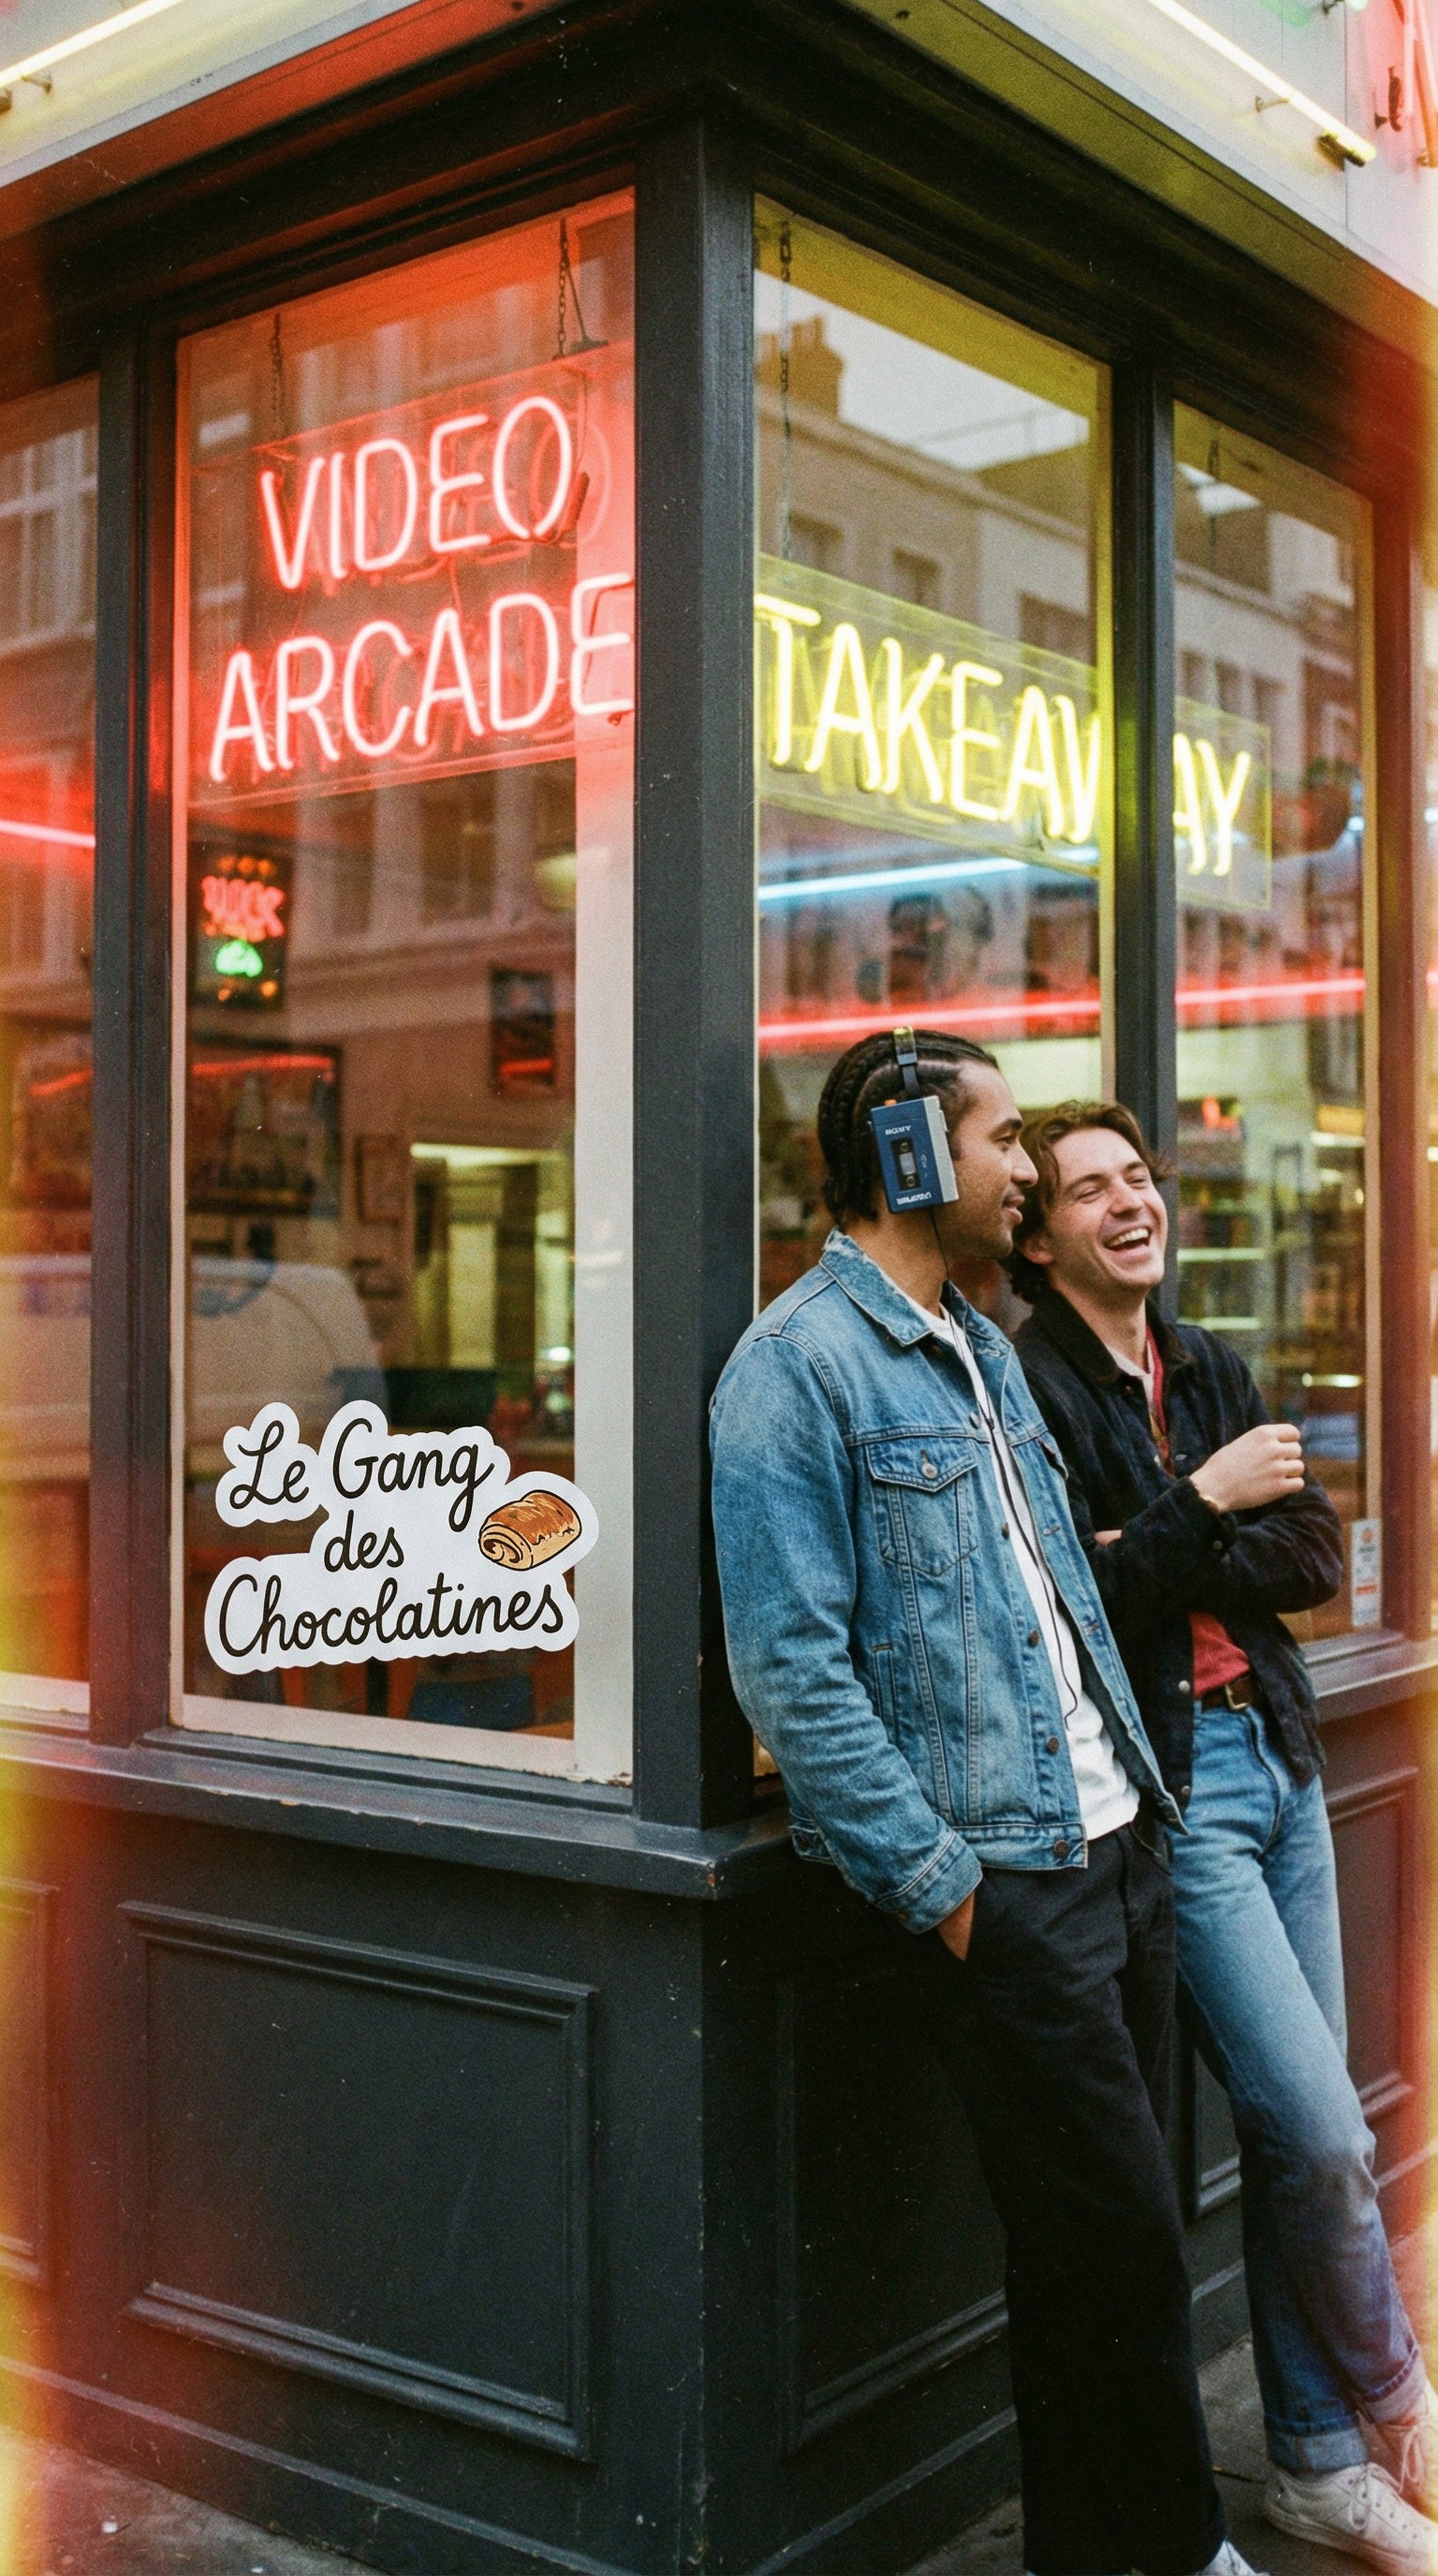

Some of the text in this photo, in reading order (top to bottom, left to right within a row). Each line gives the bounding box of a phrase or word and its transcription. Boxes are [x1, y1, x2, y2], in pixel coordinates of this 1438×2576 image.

[261, 395, 574, 590] VIDEO
[210, 570, 635, 783] ARCADE
[229, 1418, 495, 1532] Le Gang
[324, 1510, 404, 1573] des
[219, 1573, 564, 1658] Chocolatines
